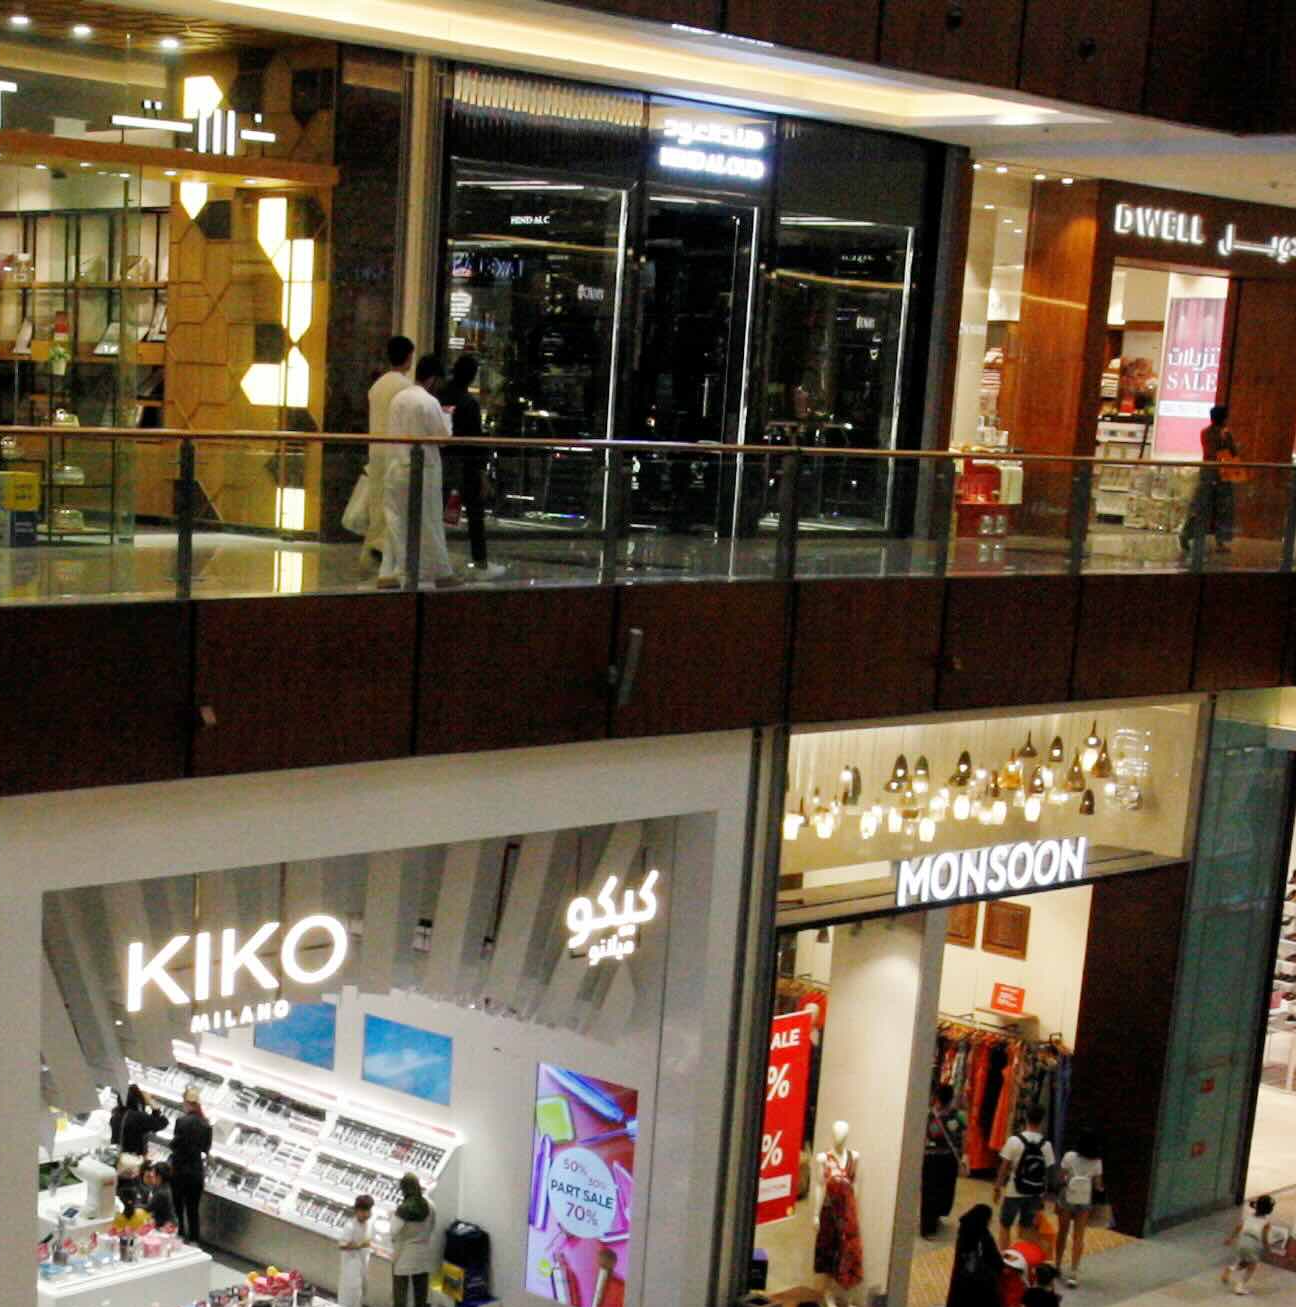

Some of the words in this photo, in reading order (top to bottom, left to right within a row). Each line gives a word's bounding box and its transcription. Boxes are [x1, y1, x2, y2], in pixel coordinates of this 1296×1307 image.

[1114, 203, 1205, 245] DWELL
[1166, 372, 1218, 392] SALE
[896, 836, 1089, 907] MONSOON
[566, 868, 660, 950] كيكو
[124, 914, 348, 1012] KIKO
[189, 998, 290, 1033] MILANO
[770, 1027, 801, 1050] ALE
[562, 1157, 589, 1178] 50%
[550, 1178, 581, 1201] PART
[582, 1188, 615, 1210] SALE
[565, 1202, 599, 1227] 70%
